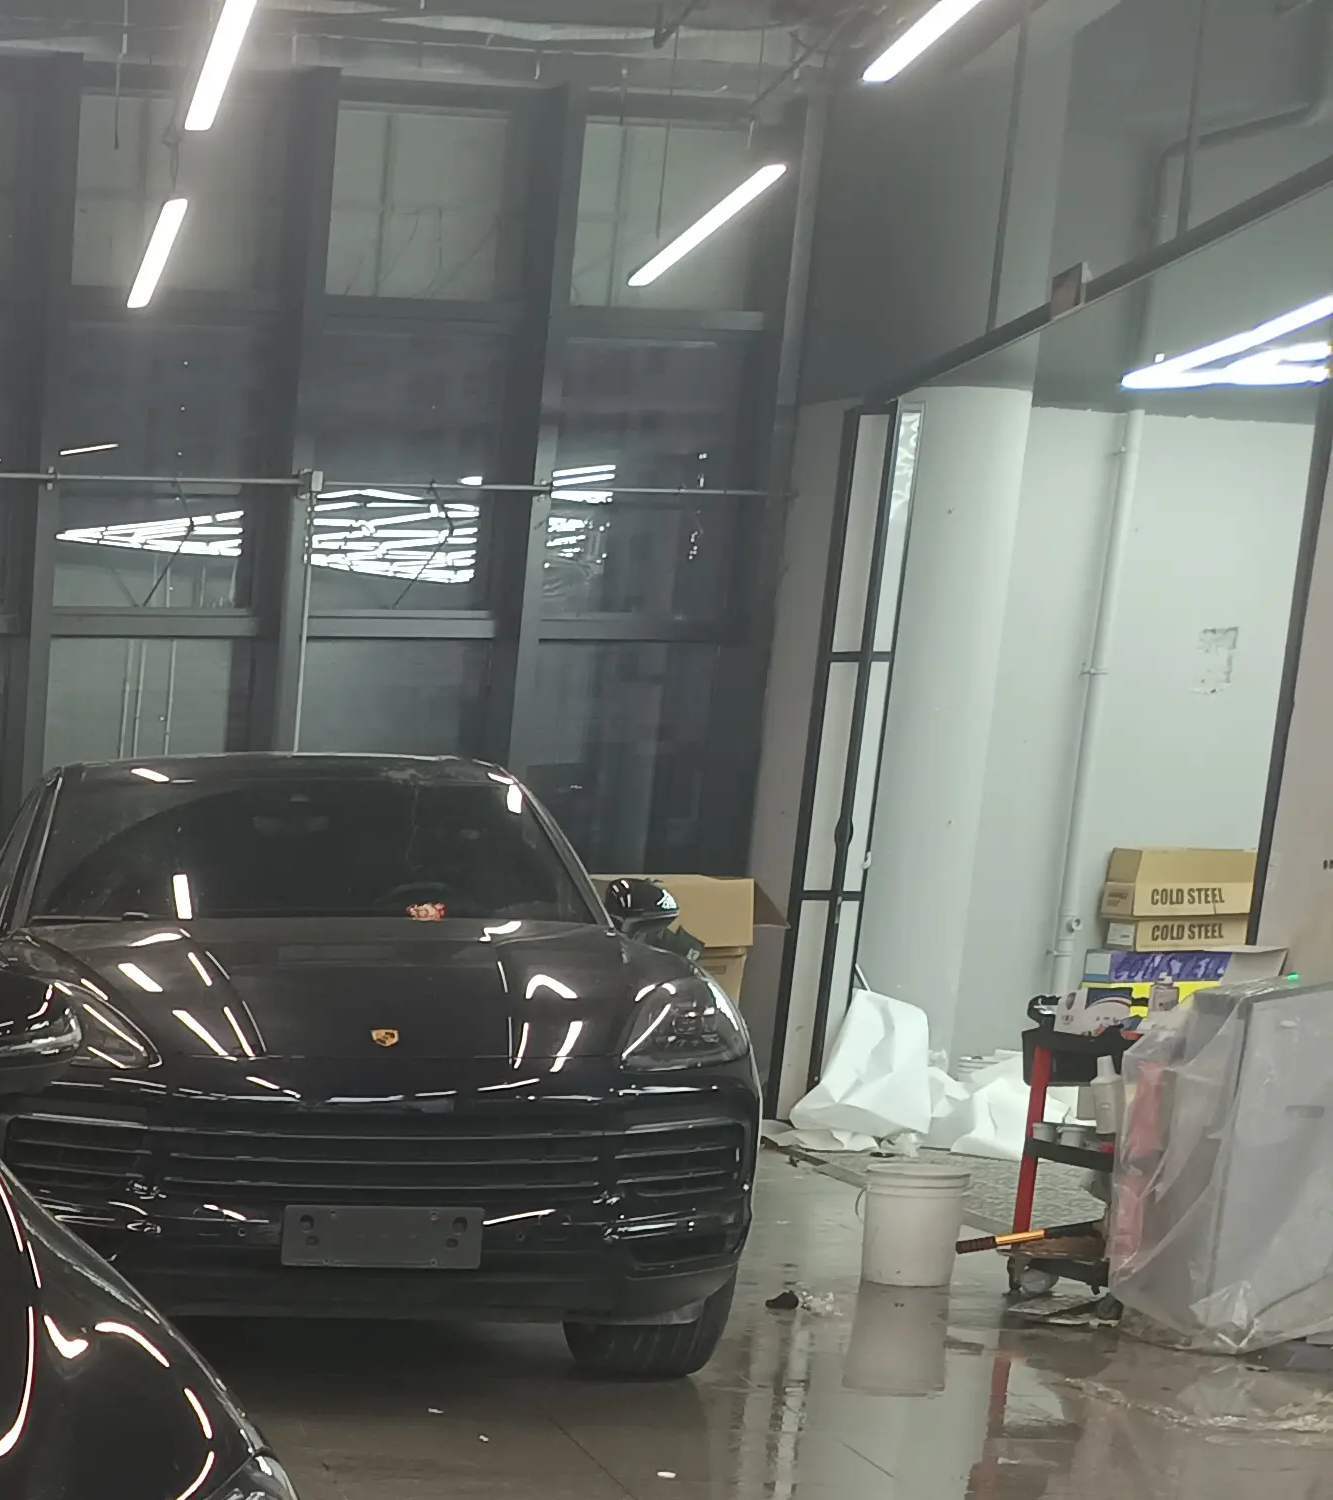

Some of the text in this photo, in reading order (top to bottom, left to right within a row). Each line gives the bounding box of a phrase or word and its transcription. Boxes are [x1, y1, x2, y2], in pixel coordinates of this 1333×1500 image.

[1150, 887, 1225, 905] COLD STEEL
[1151, 922, 1224, 941] COLD STEEL
